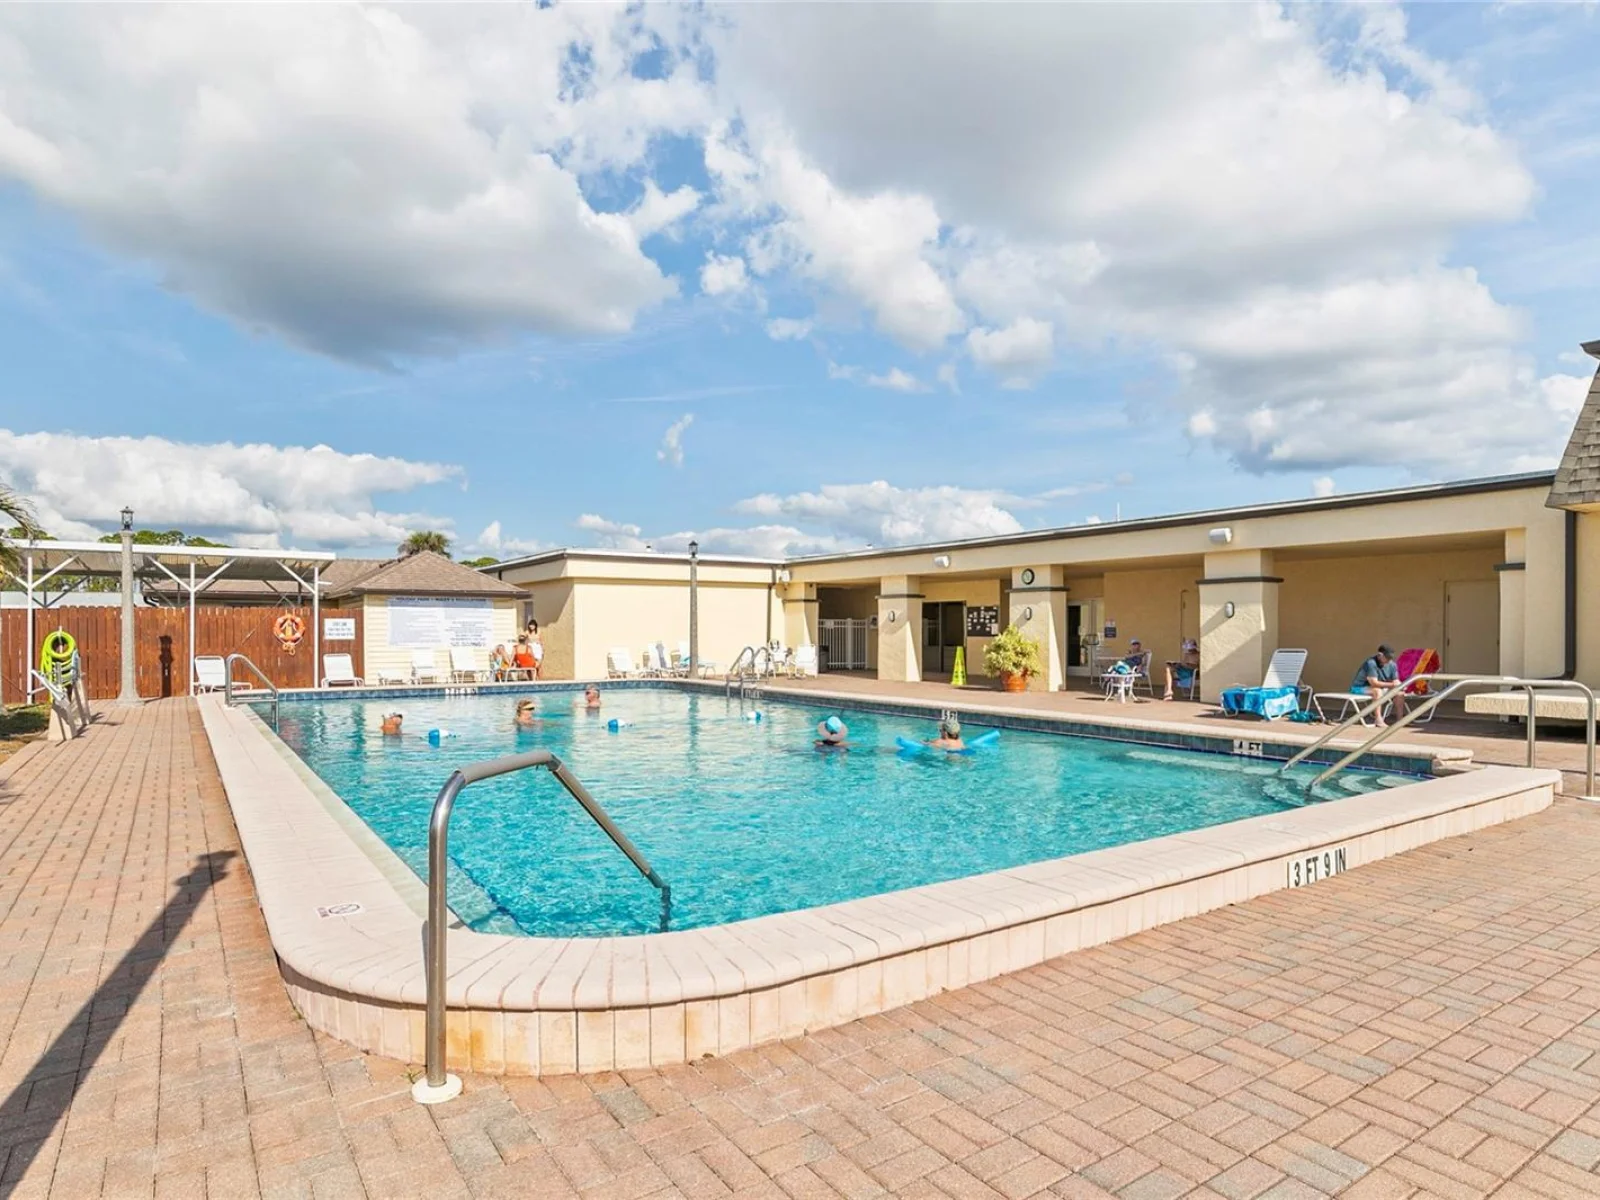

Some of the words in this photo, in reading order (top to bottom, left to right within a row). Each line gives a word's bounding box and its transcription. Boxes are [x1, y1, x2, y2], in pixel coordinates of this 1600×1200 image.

[1294, 861, 1301, 887] 3
[1305, 856, 1319, 885] FT
[1323, 852, 1331, 878] 9
[1335, 847, 1346, 875] IN
